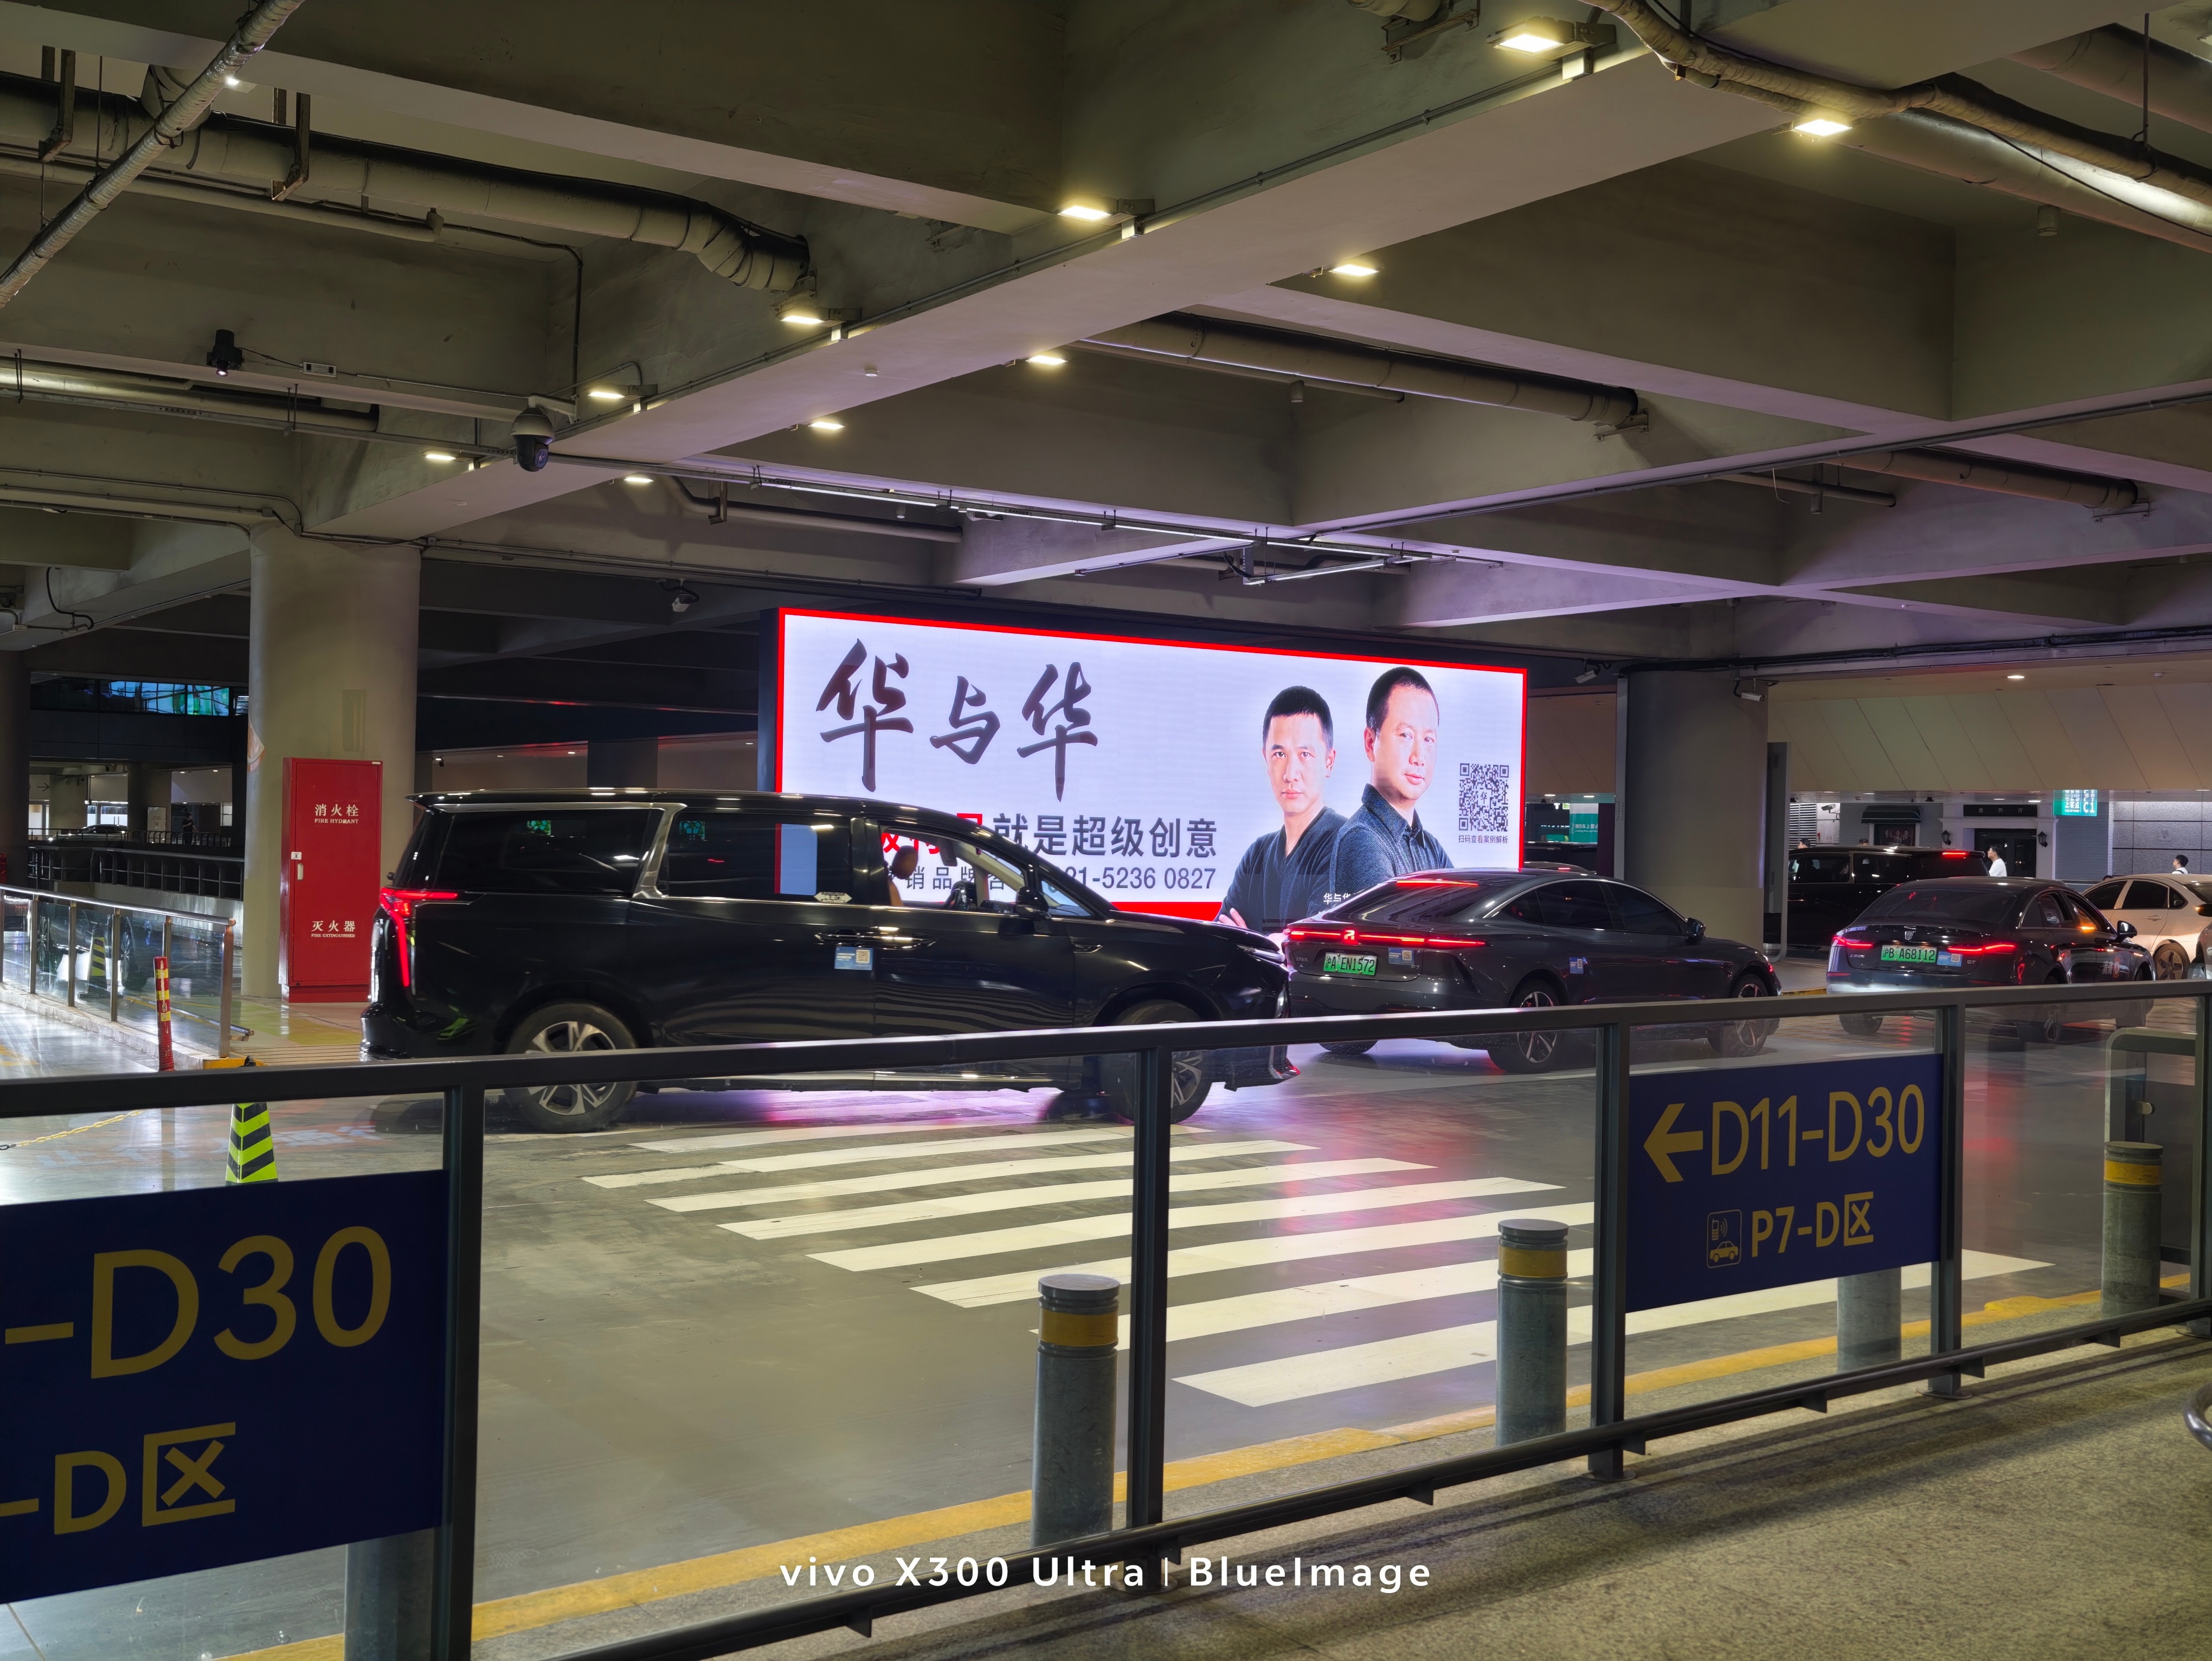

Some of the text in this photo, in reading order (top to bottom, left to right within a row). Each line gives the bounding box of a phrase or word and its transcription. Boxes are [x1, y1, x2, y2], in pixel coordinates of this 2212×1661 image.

[815, 638, 1098, 802] 华与华
[1480, 791, 1488, 804] 华
[314, 803, 359, 817] 消火栓
[2083, 801, 2095, 813] C1
[881, 813, 1217, 858] 就是超级创意
[1458, 834, 1508, 844] 扫码查看案例解析
[1164, 868, 1216, 890] 0827
[311, 919, 356, 932] 灭火器
[1711, 1084, 1925, 1175] D11-D30
[1751, 1191, 1874, 1258] P7-D区
